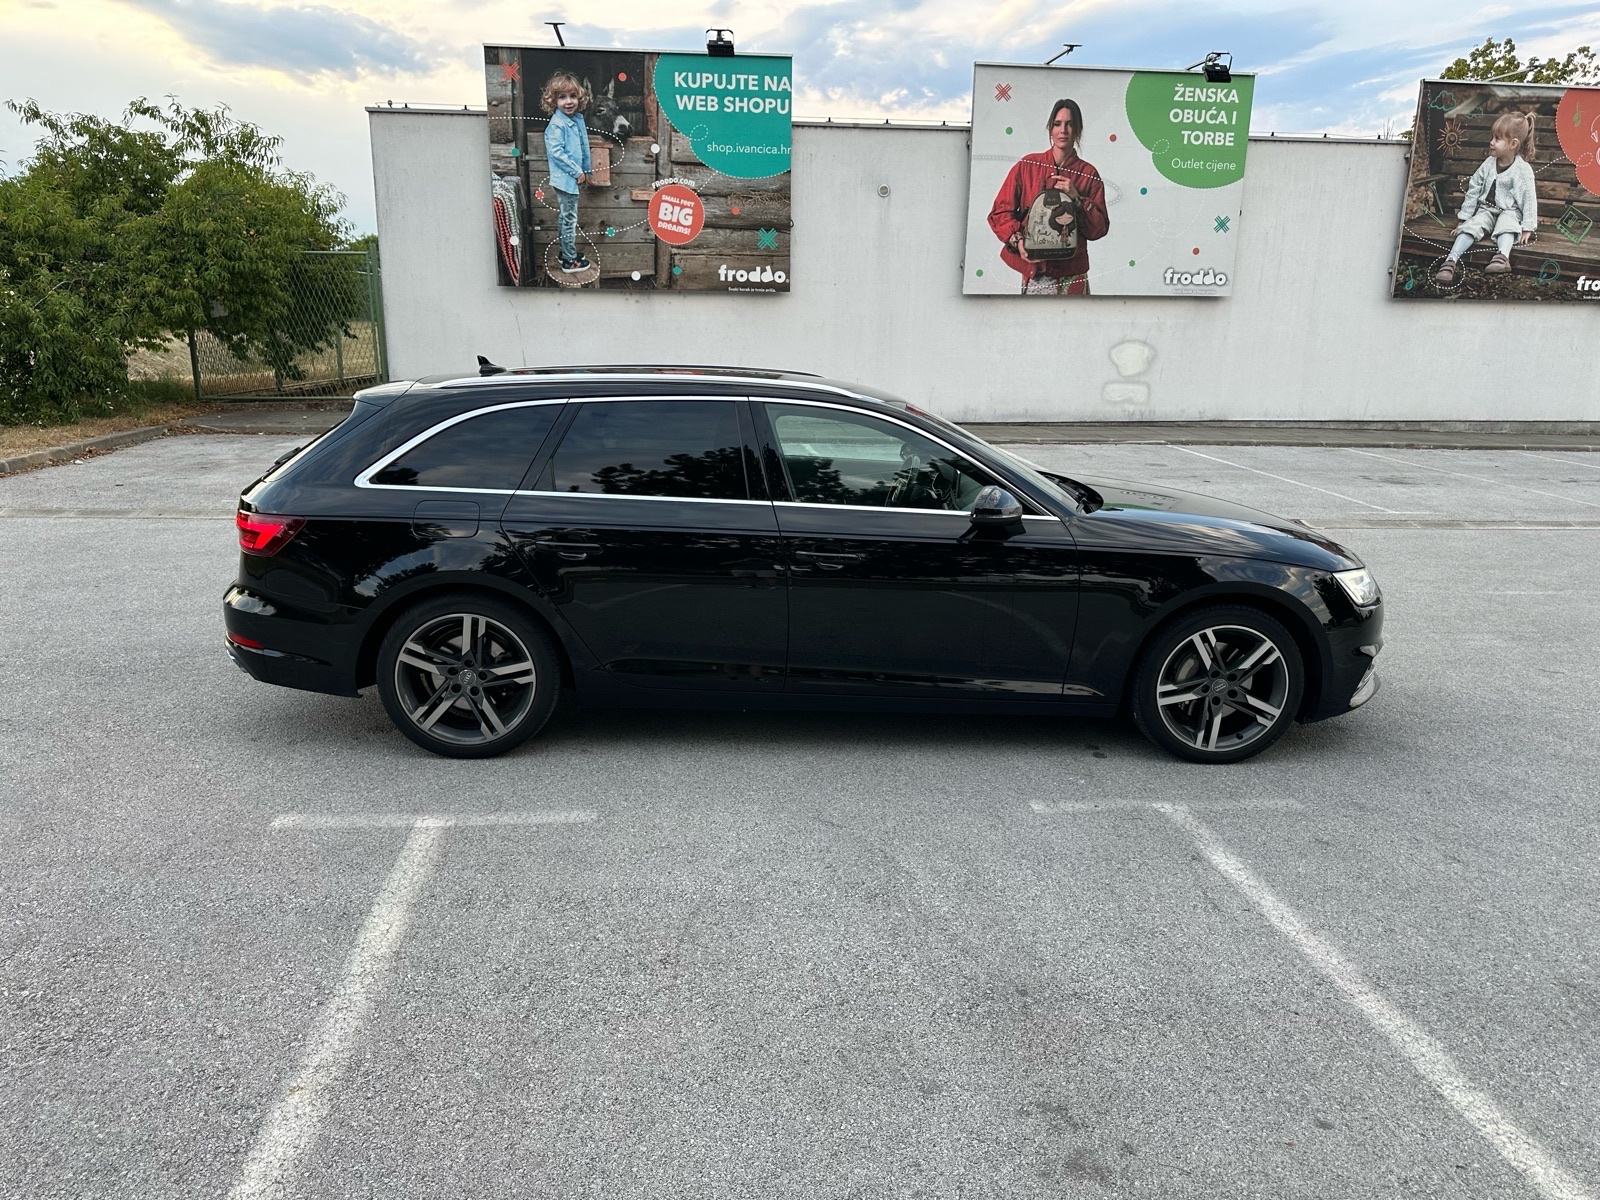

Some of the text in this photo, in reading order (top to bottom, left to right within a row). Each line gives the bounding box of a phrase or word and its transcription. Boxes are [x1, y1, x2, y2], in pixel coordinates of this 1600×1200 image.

[674, 72, 792, 92] KUPUJTE NA
[1173, 83, 1239, 103] ŽENSKA
[675, 94, 789, 115] WEB SHOPU
[1169, 106, 1237, 125] OBUĆA I
[706, 141, 791, 155] shop.ivancica.hr
[1181, 131, 1235, 146] TORBE
[1171, 157, 1237, 172] Outlet cijene
[658, 202, 693, 226] BIG
[1164, 267, 1227, 286] froddo
